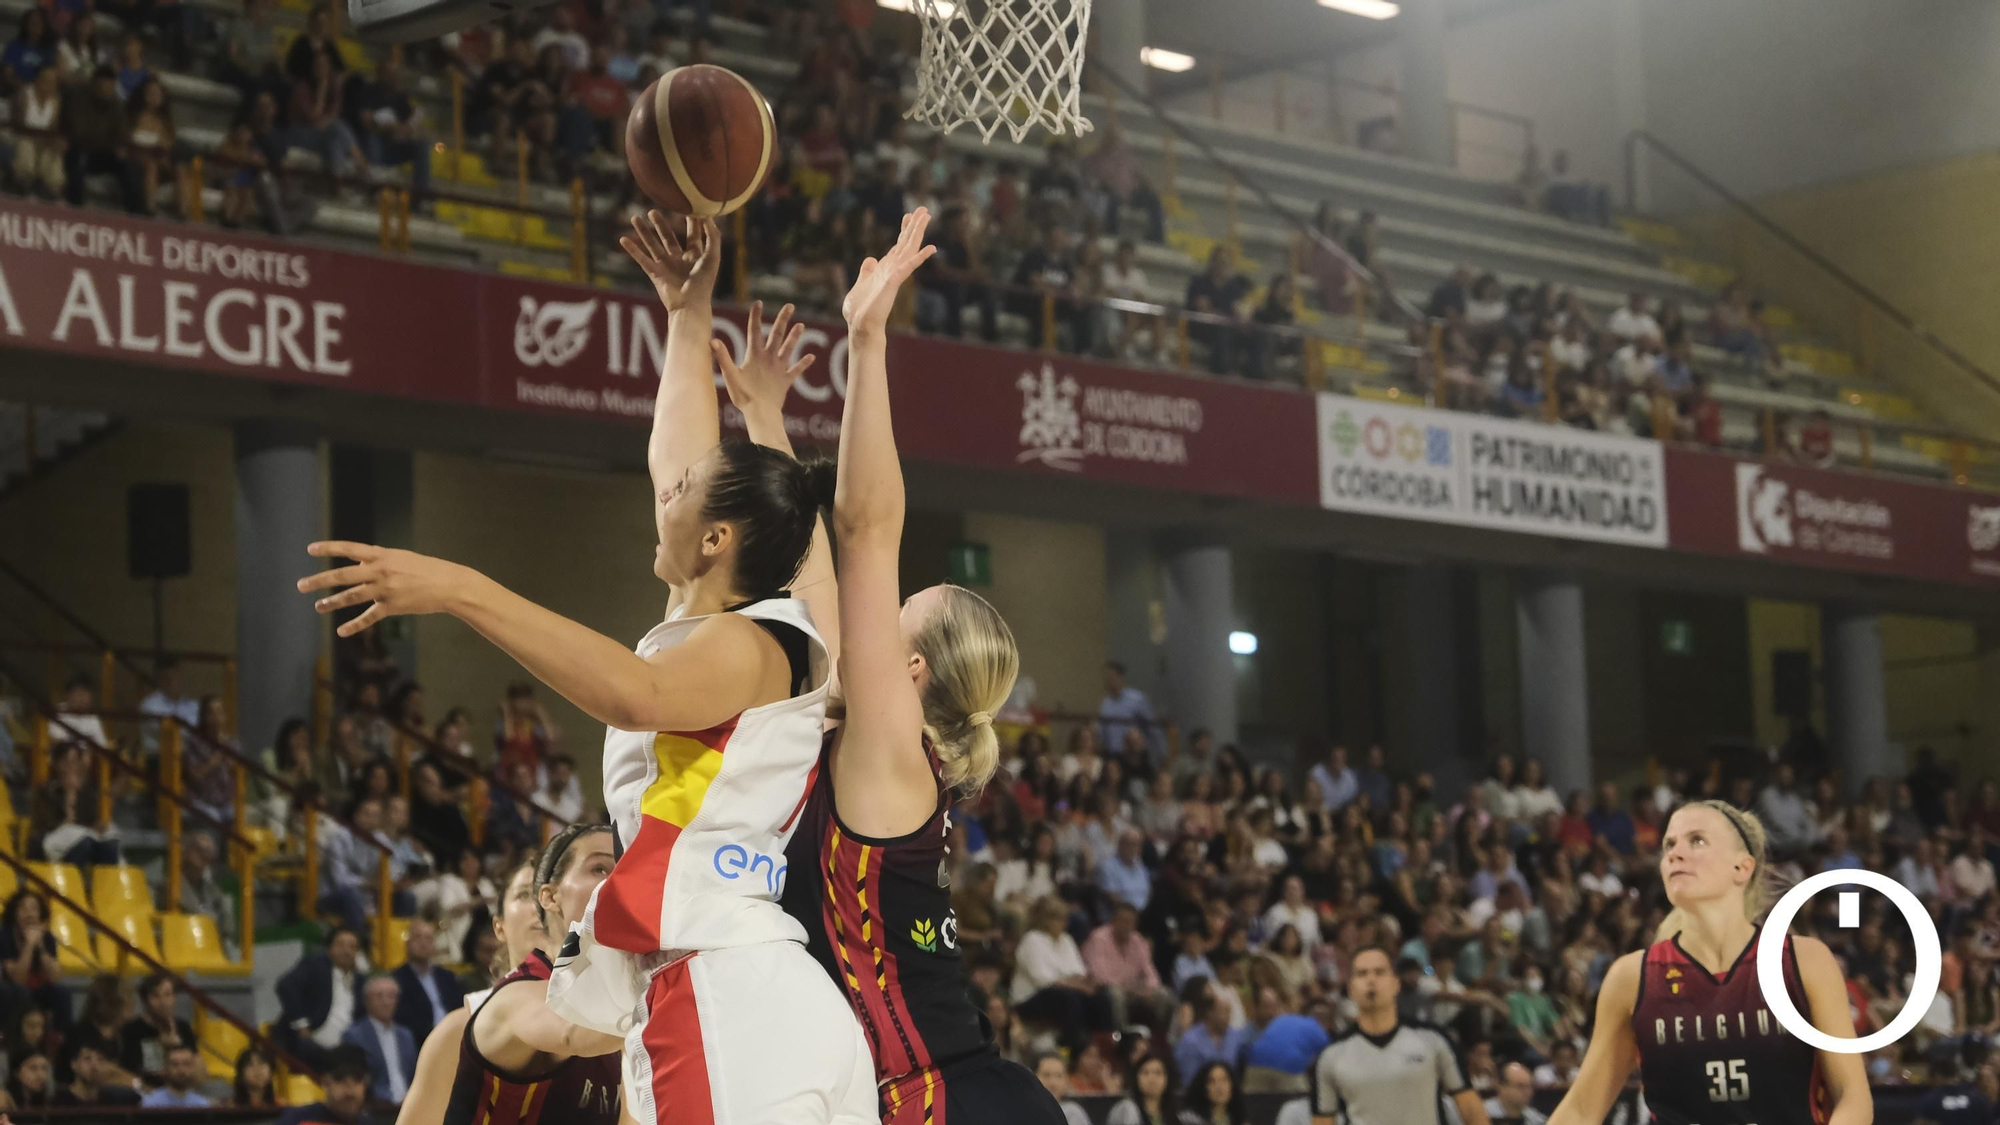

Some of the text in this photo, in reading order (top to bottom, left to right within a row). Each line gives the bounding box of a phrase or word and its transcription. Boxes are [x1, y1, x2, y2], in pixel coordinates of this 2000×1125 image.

[162, 236, 309, 288] DEPORTES
[52, 267, 353, 377] ALEGRE
[1470, 431, 1632, 484] PATRIMONIO
[1471, 472, 1656, 533] HUMANIDAD
[1705, 1058, 1750, 1102] 35
